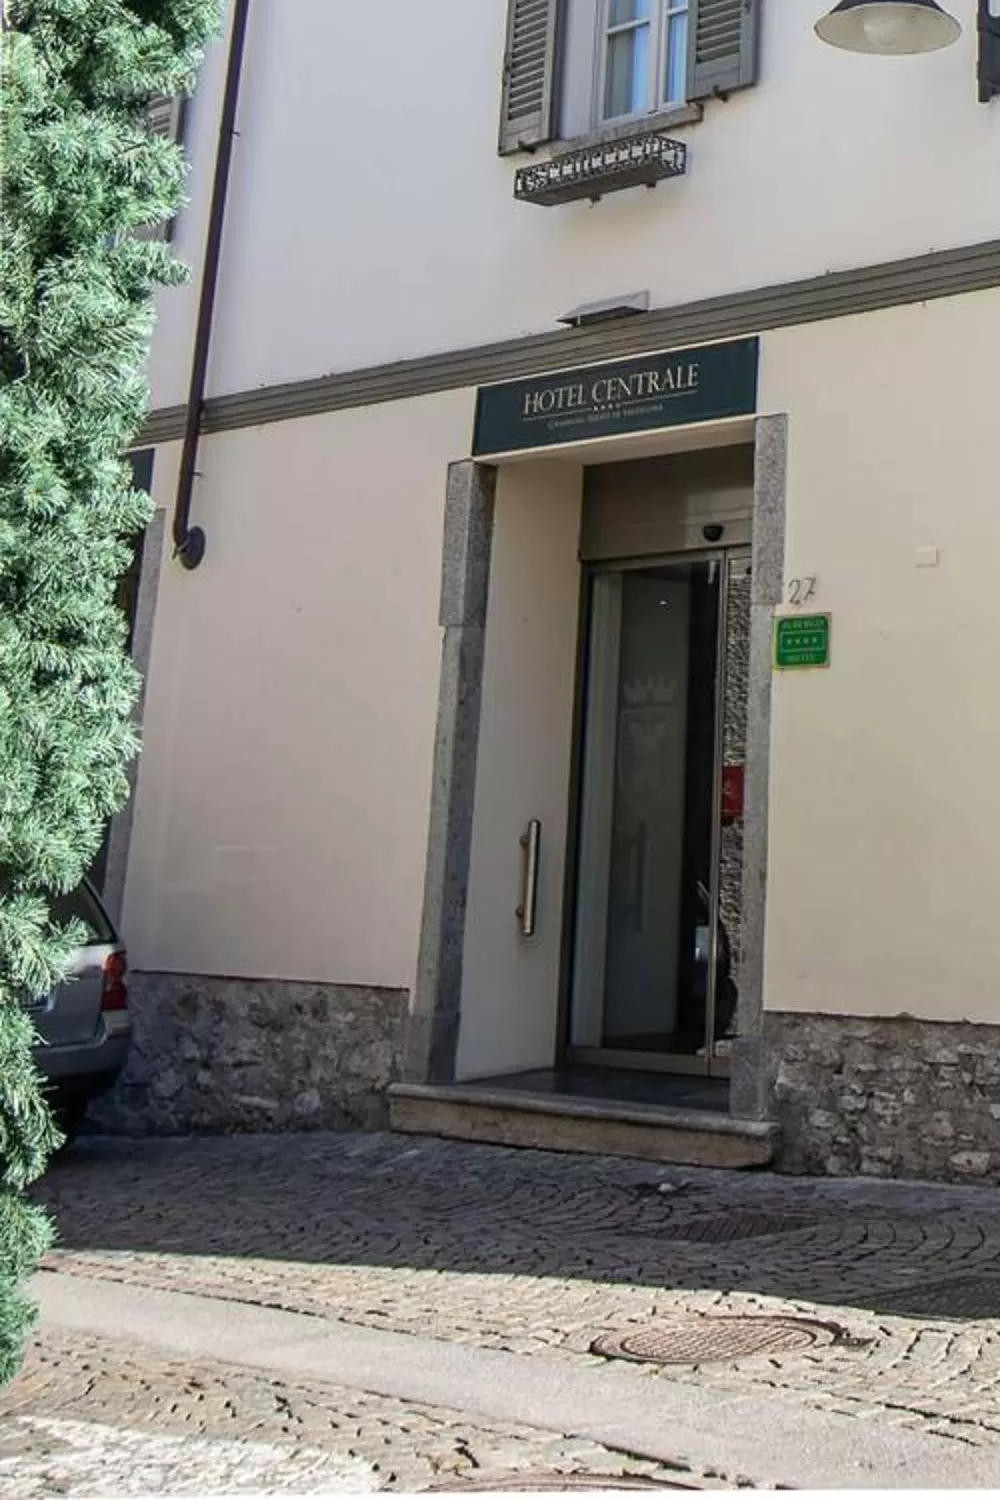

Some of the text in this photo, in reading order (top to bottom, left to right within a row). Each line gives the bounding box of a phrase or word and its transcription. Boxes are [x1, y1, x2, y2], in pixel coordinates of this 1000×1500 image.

[524, 383, 586, 415] HOTEL
[591, 363, 700, 403] CENTRALE
[788, 576, 817, 605] 27
